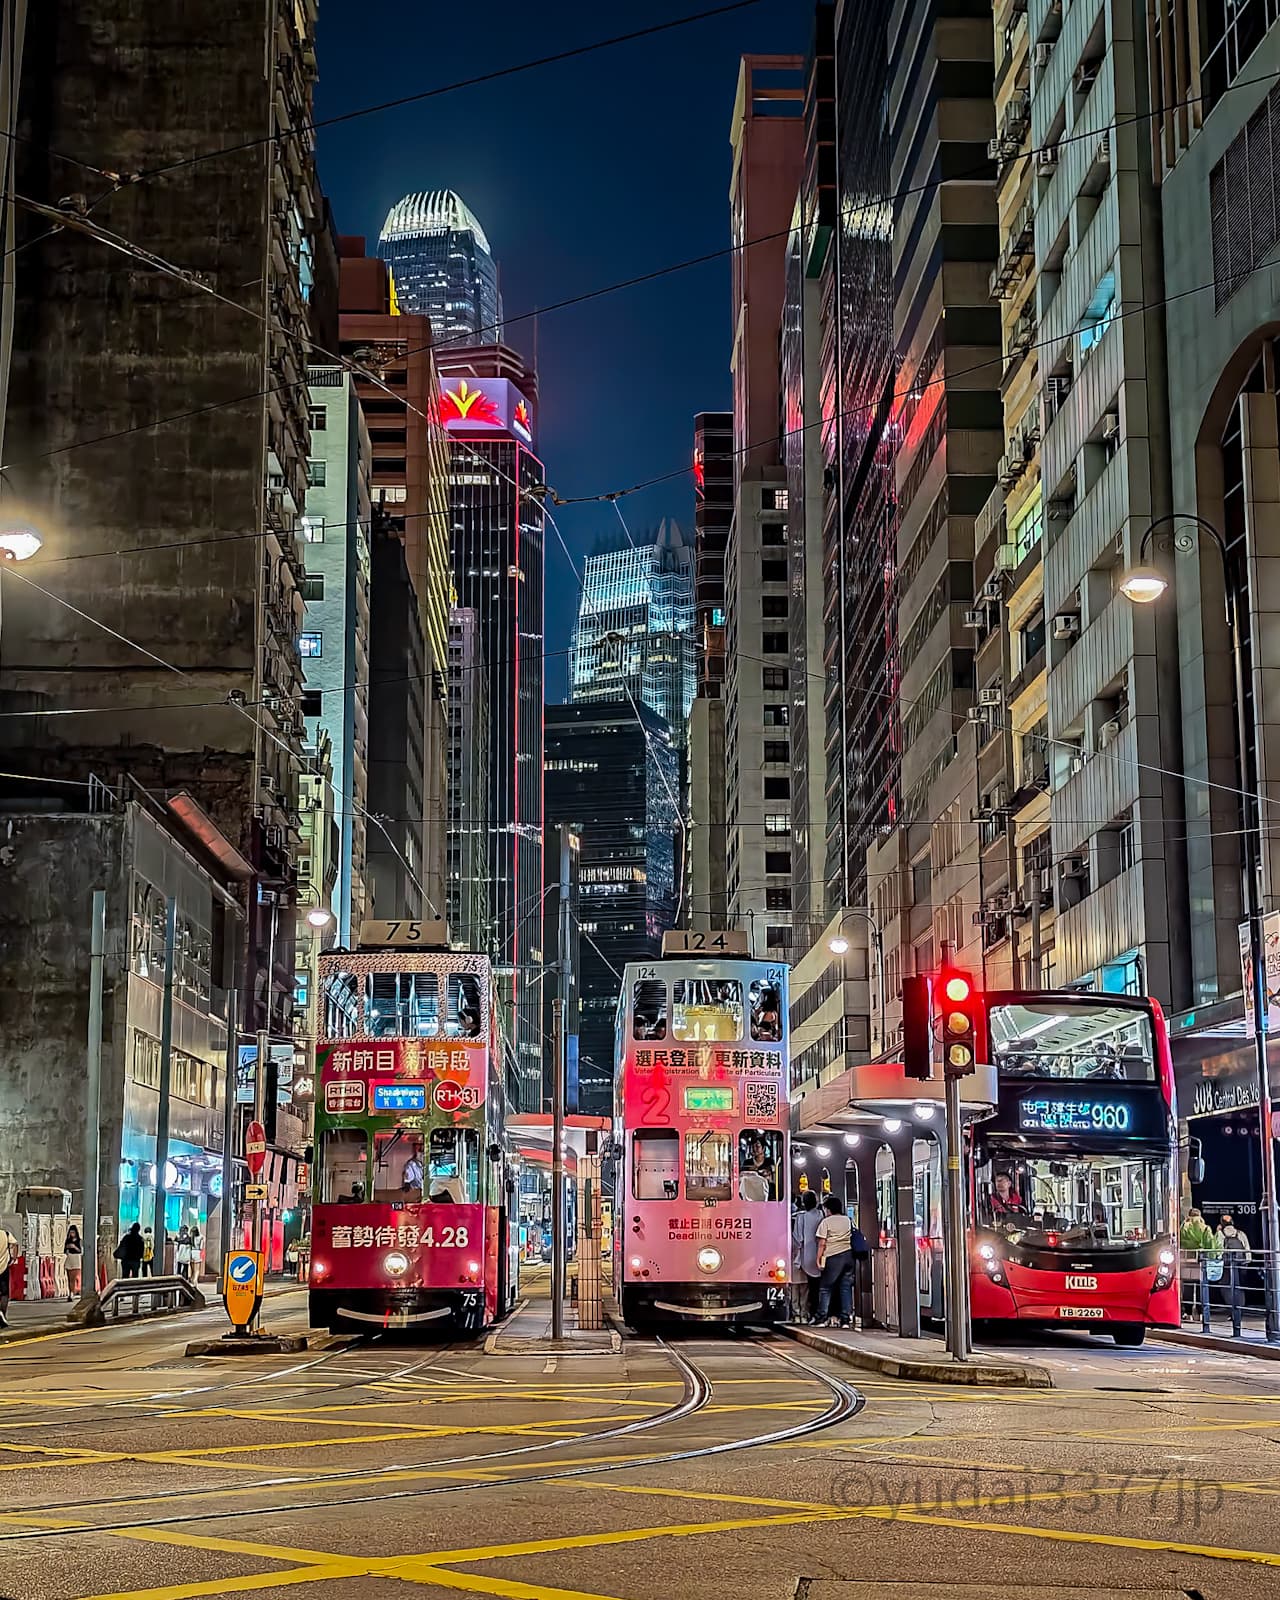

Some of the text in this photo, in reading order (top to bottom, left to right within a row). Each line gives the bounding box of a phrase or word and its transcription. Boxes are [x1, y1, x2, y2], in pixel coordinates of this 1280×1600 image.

[385, 922, 422, 941] 75
[683, 933, 729, 950] 124
[463, 960, 478, 972] 75
[638, 967, 656, 979] 124
[766, 968, 783, 979] 124
[332, 1050, 471, 1073] 新節目 新時段
[330, 1086, 361, 1095] RTHK
[1214, 1085, 1236, 1109] Central
[1236, 1085, 1250, 1105] Des
[1091, 1104, 1129, 1129] 960
[1237, 1205, 1257, 1215] 308
[714, 1218, 752, 1230] 6月2日
[668, 1231, 752, 1240] Deadline JUNE 2
[1065, 1275, 1098, 1290] KMB
[463, 1293, 477, 1307] 75
[766, 1287, 785, 1301] 124
[1061, 1308, 1102, 1317] YB 2269
